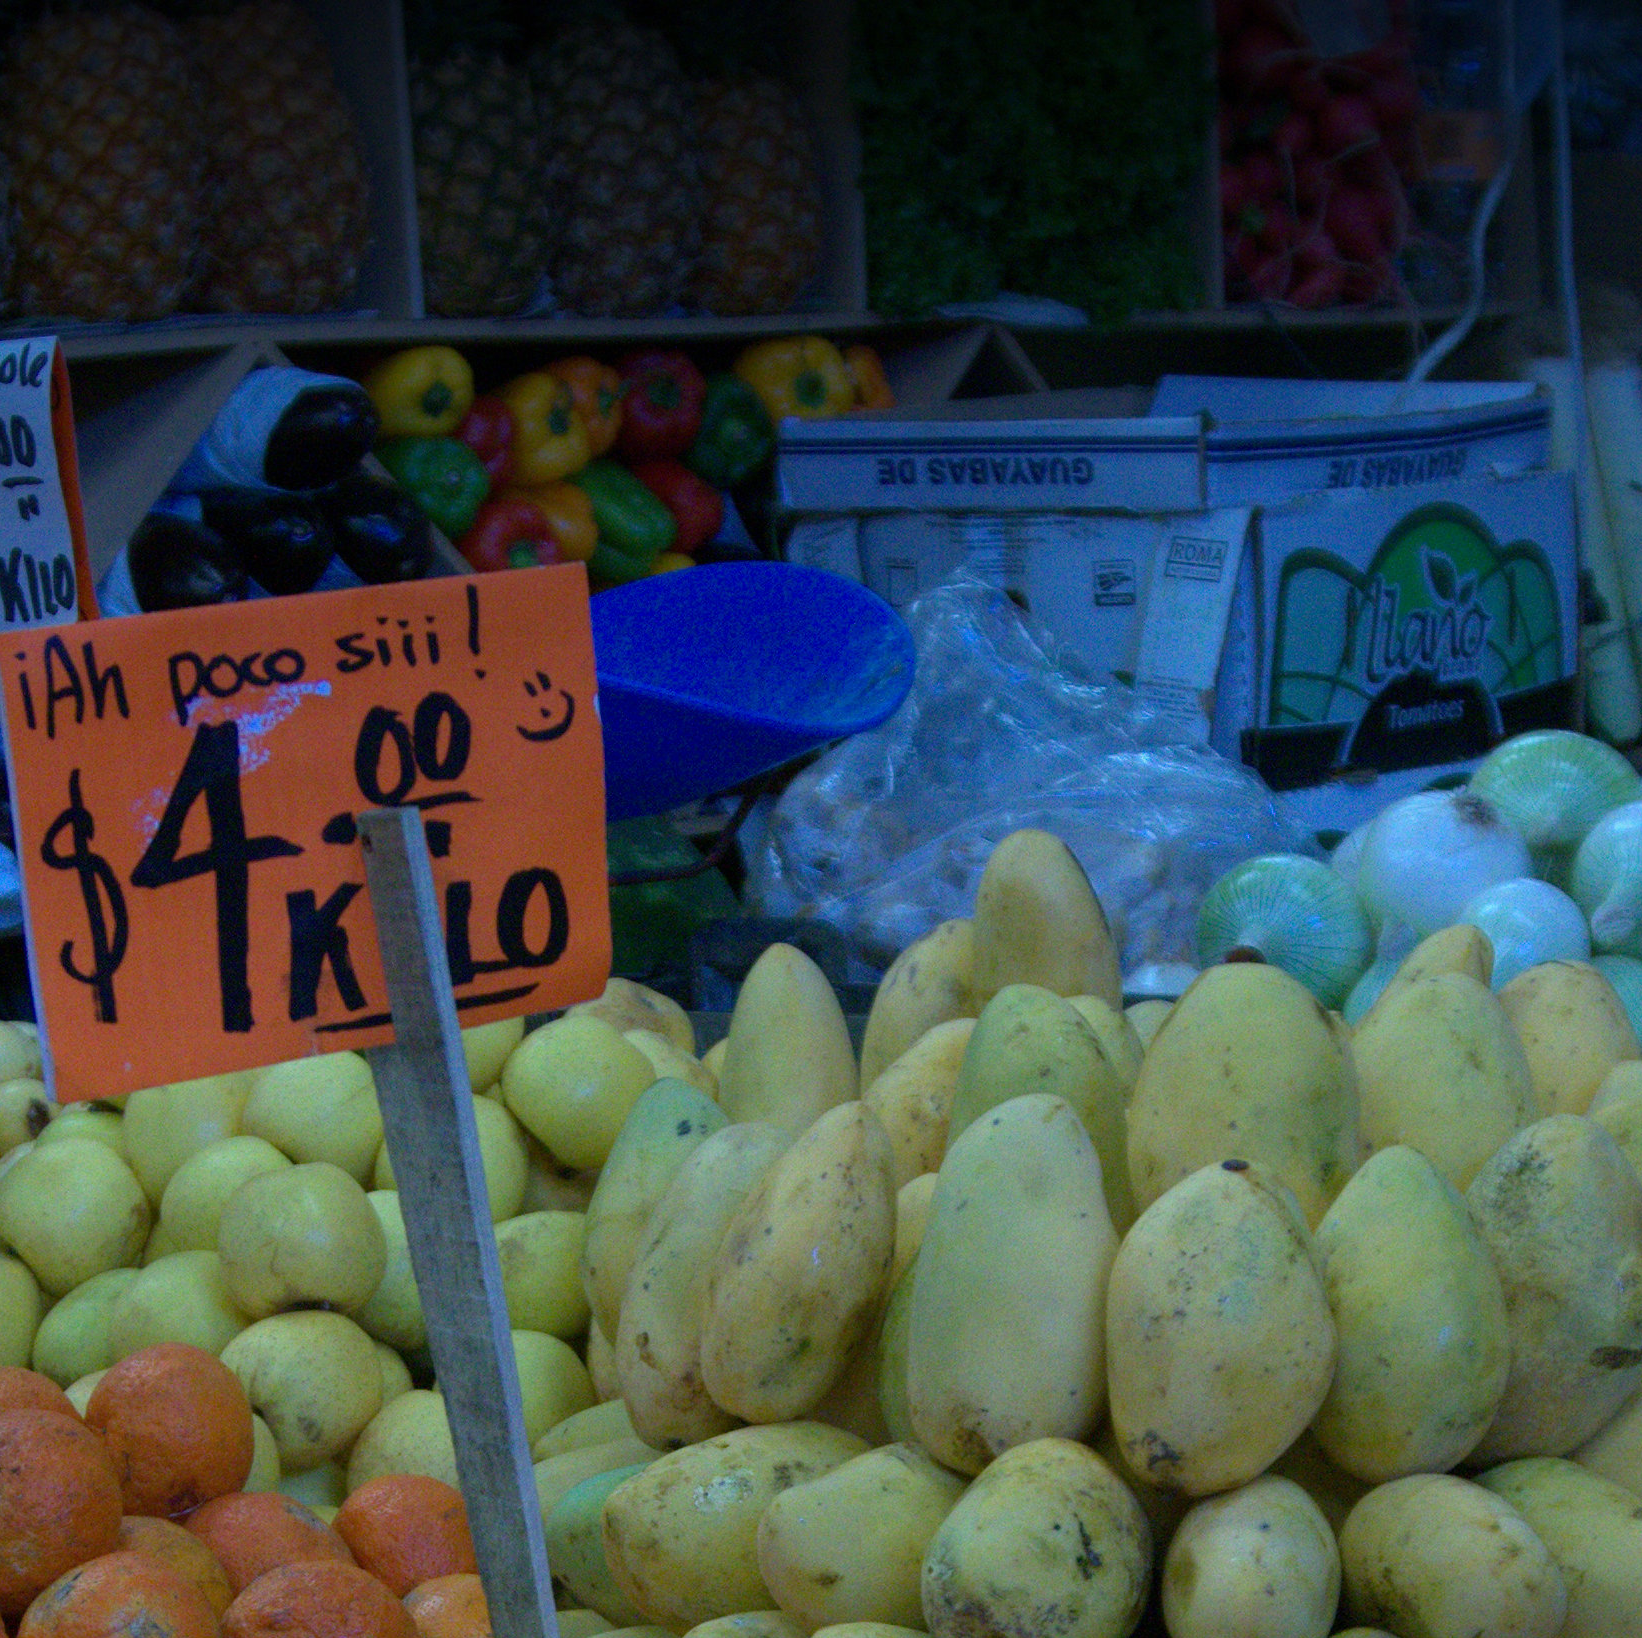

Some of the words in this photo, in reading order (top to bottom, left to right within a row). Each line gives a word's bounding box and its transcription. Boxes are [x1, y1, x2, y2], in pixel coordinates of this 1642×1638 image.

[876, 455, 917, 486] DE
[927, 455, 1095, 486] GUAYABAS
[1326, 458, 1357, 489] DE
[1360, 447, 1468, 490] GUAYABAS
[1173, 543, 1223, 563] ROMA
[15, 633, 130, 739] ¡Ah
[167, 646, 306, 726] poco
[1385, 698, 1466, 730] Tomatoes
[285, 867, 569, 1023] KLO
